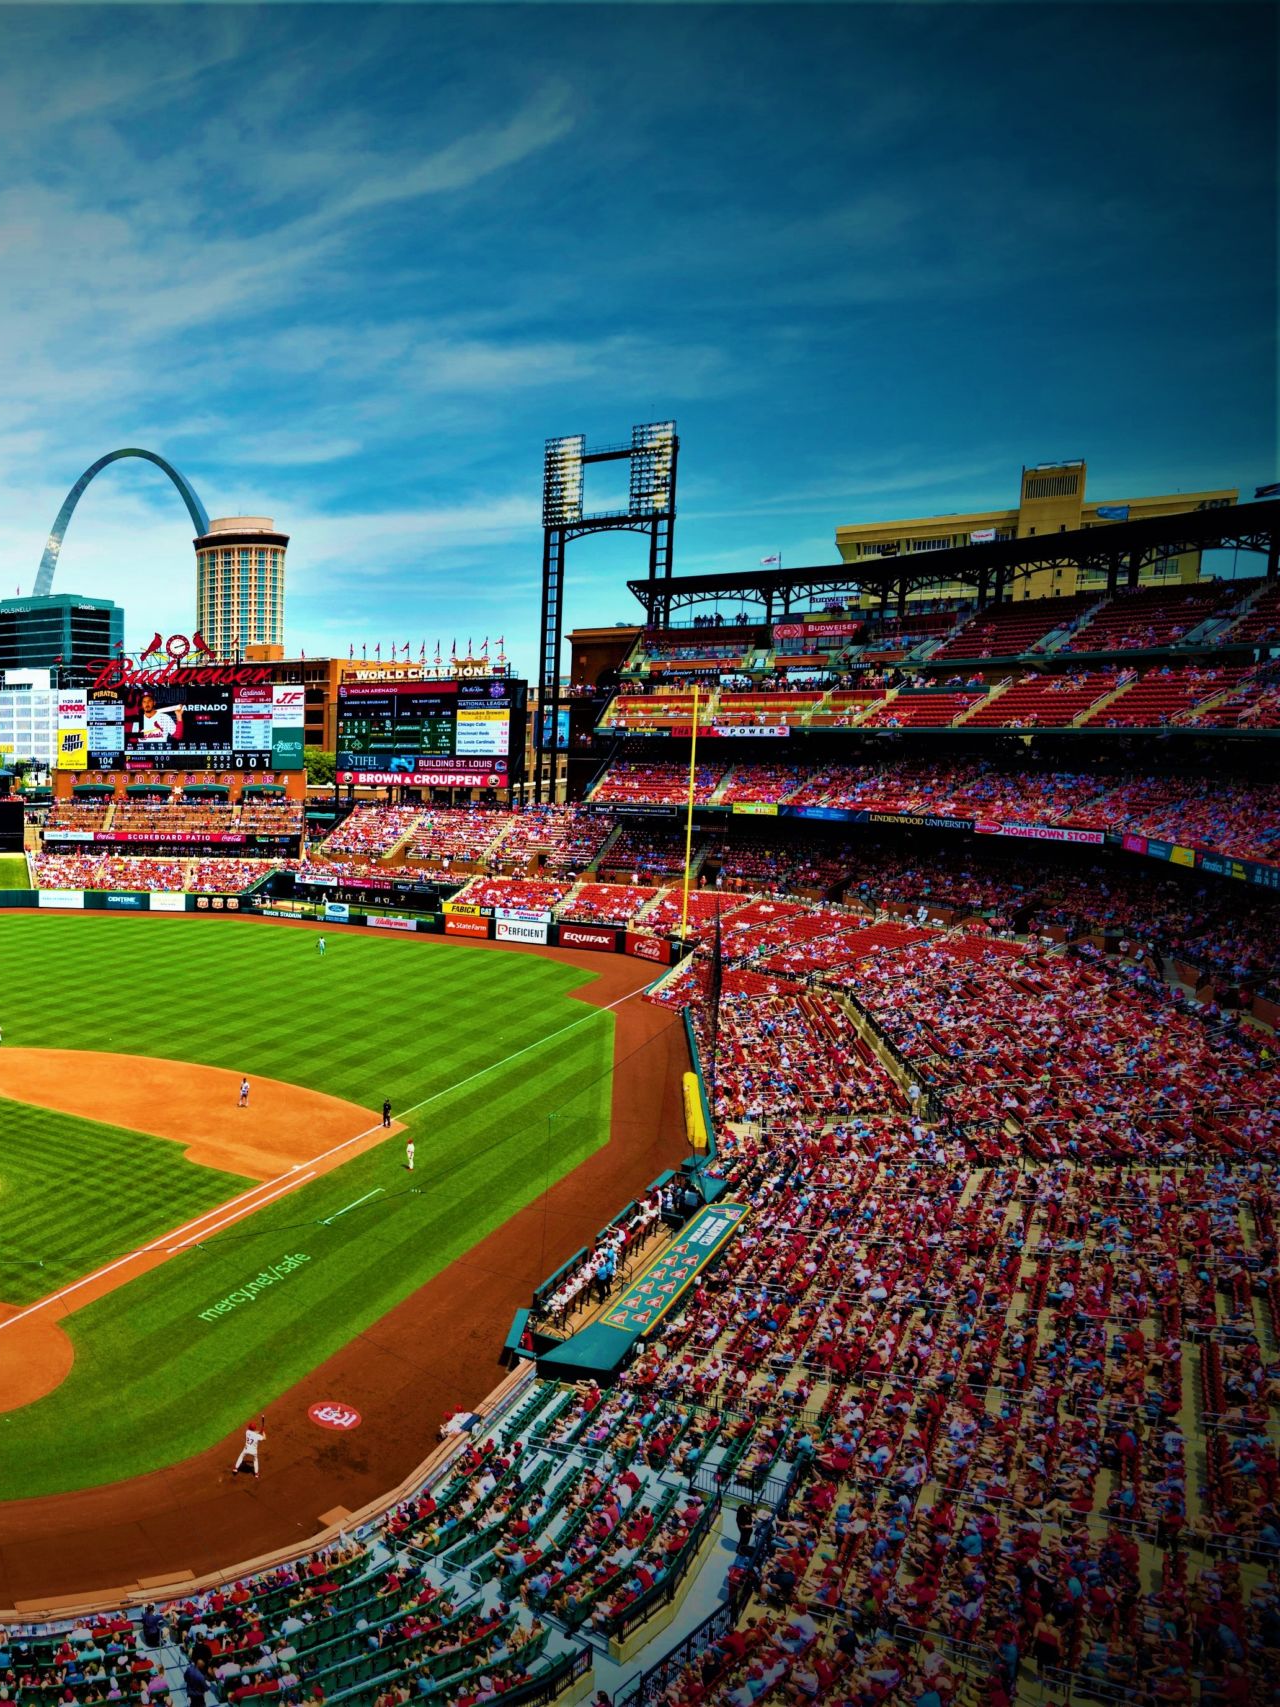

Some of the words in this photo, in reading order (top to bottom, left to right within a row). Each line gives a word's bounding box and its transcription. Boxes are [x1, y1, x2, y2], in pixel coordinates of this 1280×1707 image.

[1, 606, 31, 614] POLSINELLI
[808, 623, 858, 632] BUDWEISER
[86, 658, 272, 690] Budweiser
[355, 670, 405, 680] WORLD
[407, 666, 493, 679] CHAMPIONS
[93, 690, 118, 699] PIRATES
[239, 688, 266, 697] Cardinals
[58, 704, 86, 712] KMOX
[64, 734, 81, 743] HOT
[61, 741, 84, 752] SHOT
[99, 757, 113, 765] 104
[235, 758, 243, 767] 0
[249, 758, 257, 767] 0
[264, 758, 269, 767] 1
[348, 755, 379, 766] STIFEL
[96, 775, 102, 784] 2
[109, 775, 116, 784] 6
[122, 775, 129, 784] 9
[135, 775, 145, 784] 10
[151, 775, 161, 784] 14
[167, 775, 179, 785] 17
[184, 775, 197, 784] 20
[203, 775, 215, 784] 24
[223, 775, 235, 784] 42
[242, 775, 254, 784] 45
[262, 775, 274, 784] 85
[358, 773, 402, 783] BROWN
[413, 774, 481, 785] CROUPPEN
[869, 815, 923, 826] LINDENWOOD
[924, 819, 973, 829] UNIVERSITY
[1003, 827, 1065, 839] HOMETOWN
[1067, 832, 1102, 843] STORE
[1202, 857, 1223, 873] Fanatics
[330, 904, 344, 912] Ford
[451, 905, 476, 913] FABICK
[480, 907, 493, 915] CAT
[263, 909, 279, 917] BUSCH
[280, 911, 302, 919] STADIUM
[375, 917, 394, 926] Bally
[471, 923, 487, 931] Farm
[497, 924, 545, 938] PERFICIENT
[563, 932, 610, 944] EQUIFAX
[197, 1253, 311, 1322] mercy.net/safe
